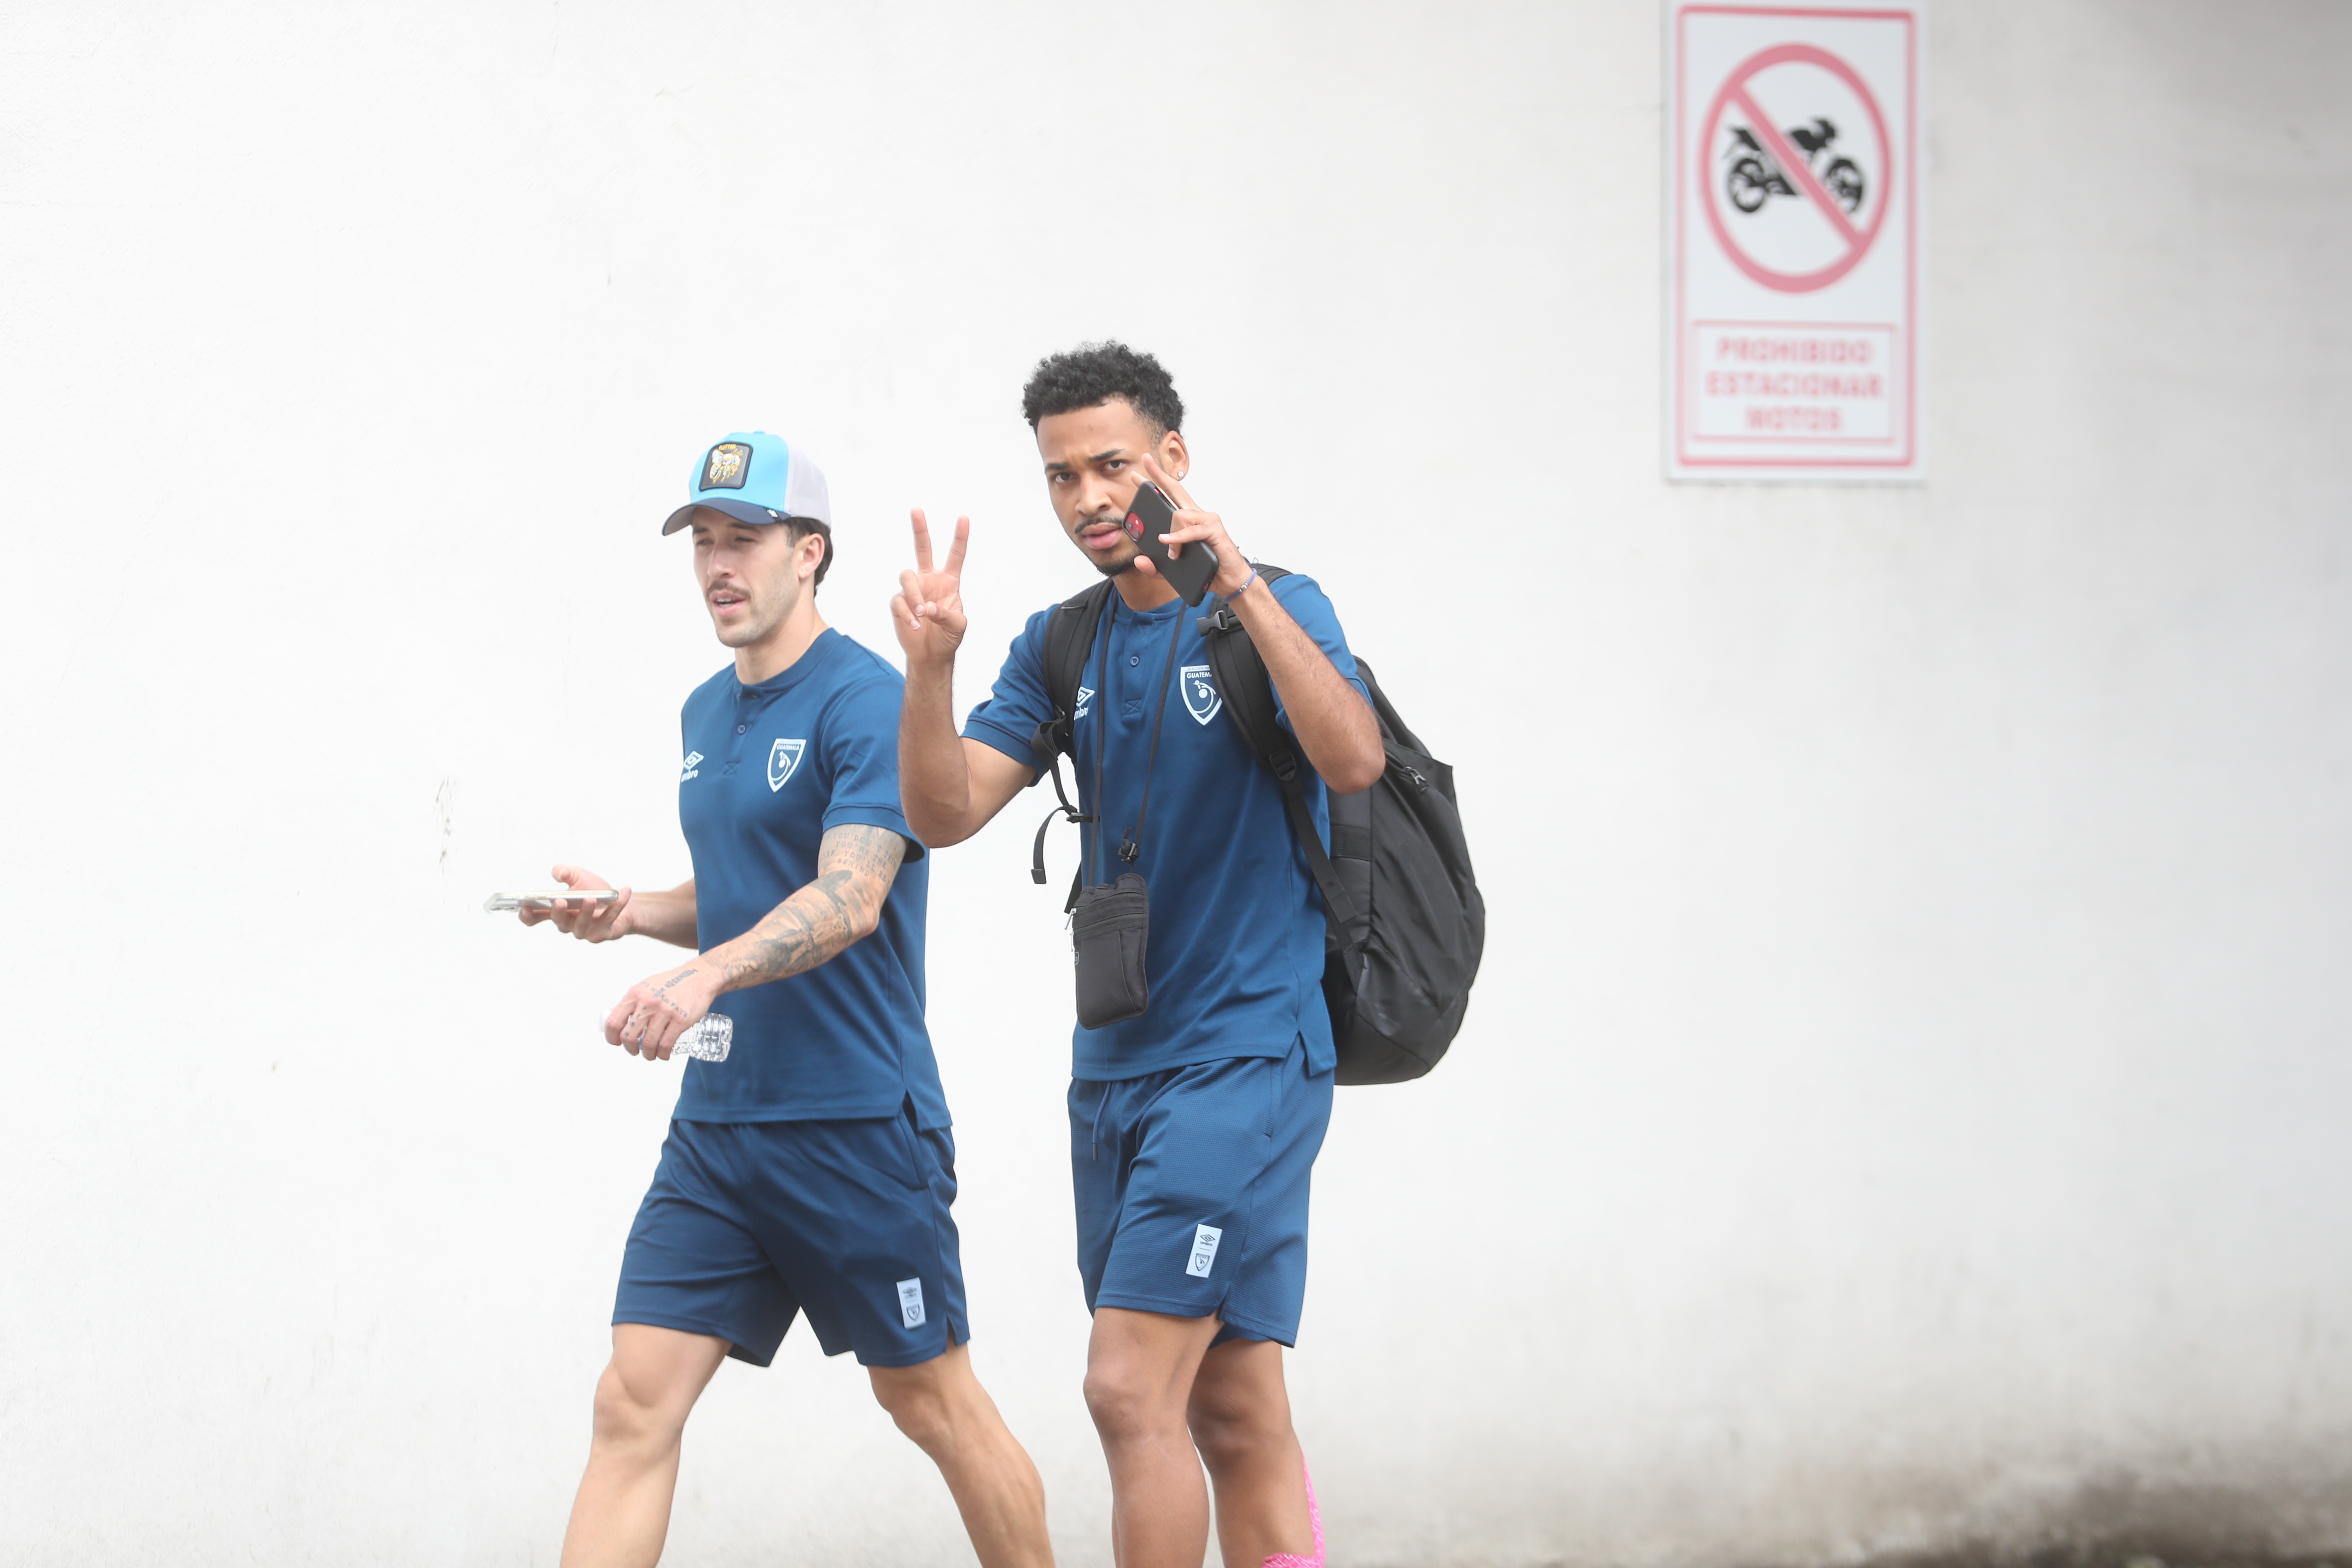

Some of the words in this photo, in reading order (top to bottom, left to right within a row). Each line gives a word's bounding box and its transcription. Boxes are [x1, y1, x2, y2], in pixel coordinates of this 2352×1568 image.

[1716, 337, 1873, 363] PROHIBIDO
[1705, 370, 1883, 397] ESTACIONAR
[1745, 405, 1843, 429] MOTOS
